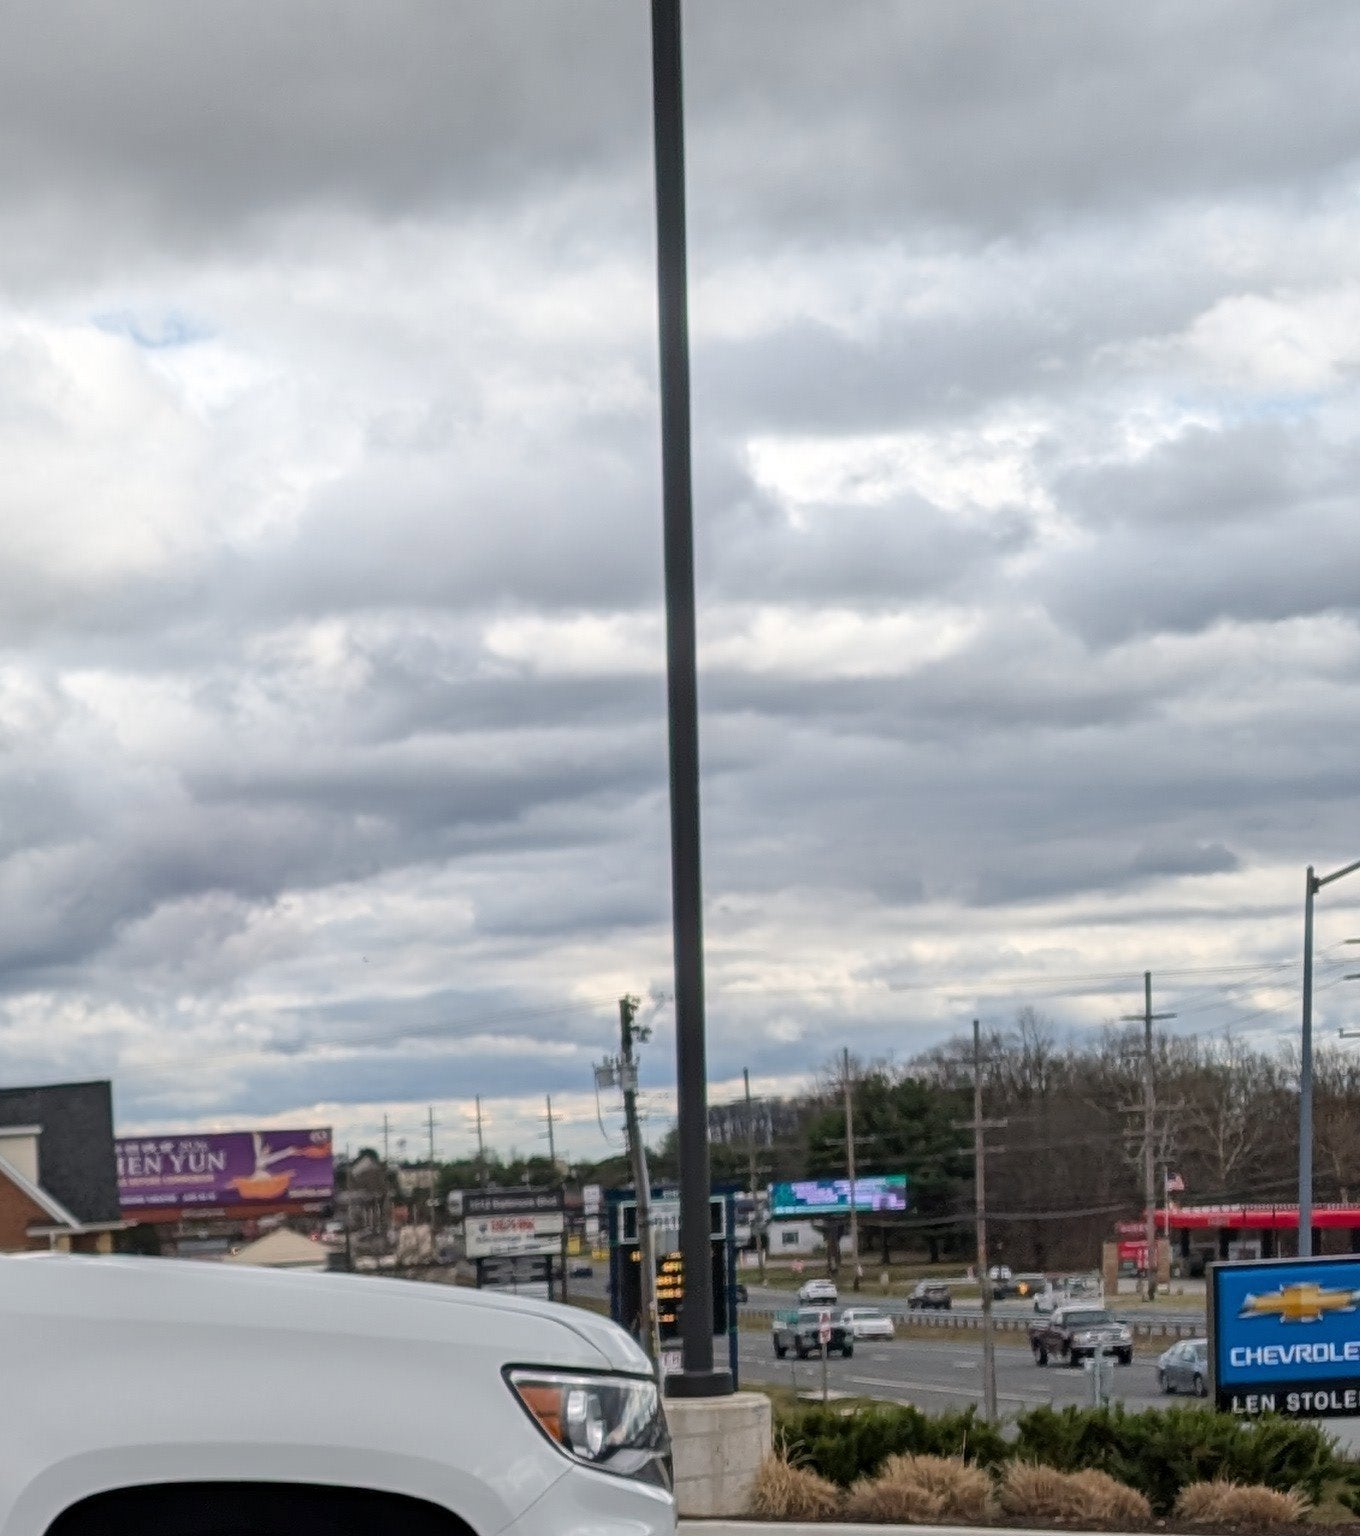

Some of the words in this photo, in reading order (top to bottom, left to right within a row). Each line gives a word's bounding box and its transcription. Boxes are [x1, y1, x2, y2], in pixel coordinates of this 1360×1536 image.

[169, 1150, 226, 1174] YUN
[1231, 1341, 1360, 1367] CHEVROLE
[1232, 1394, 1276, 1415] LEN
[1286, 1389, 1360, 1412] STOLE
